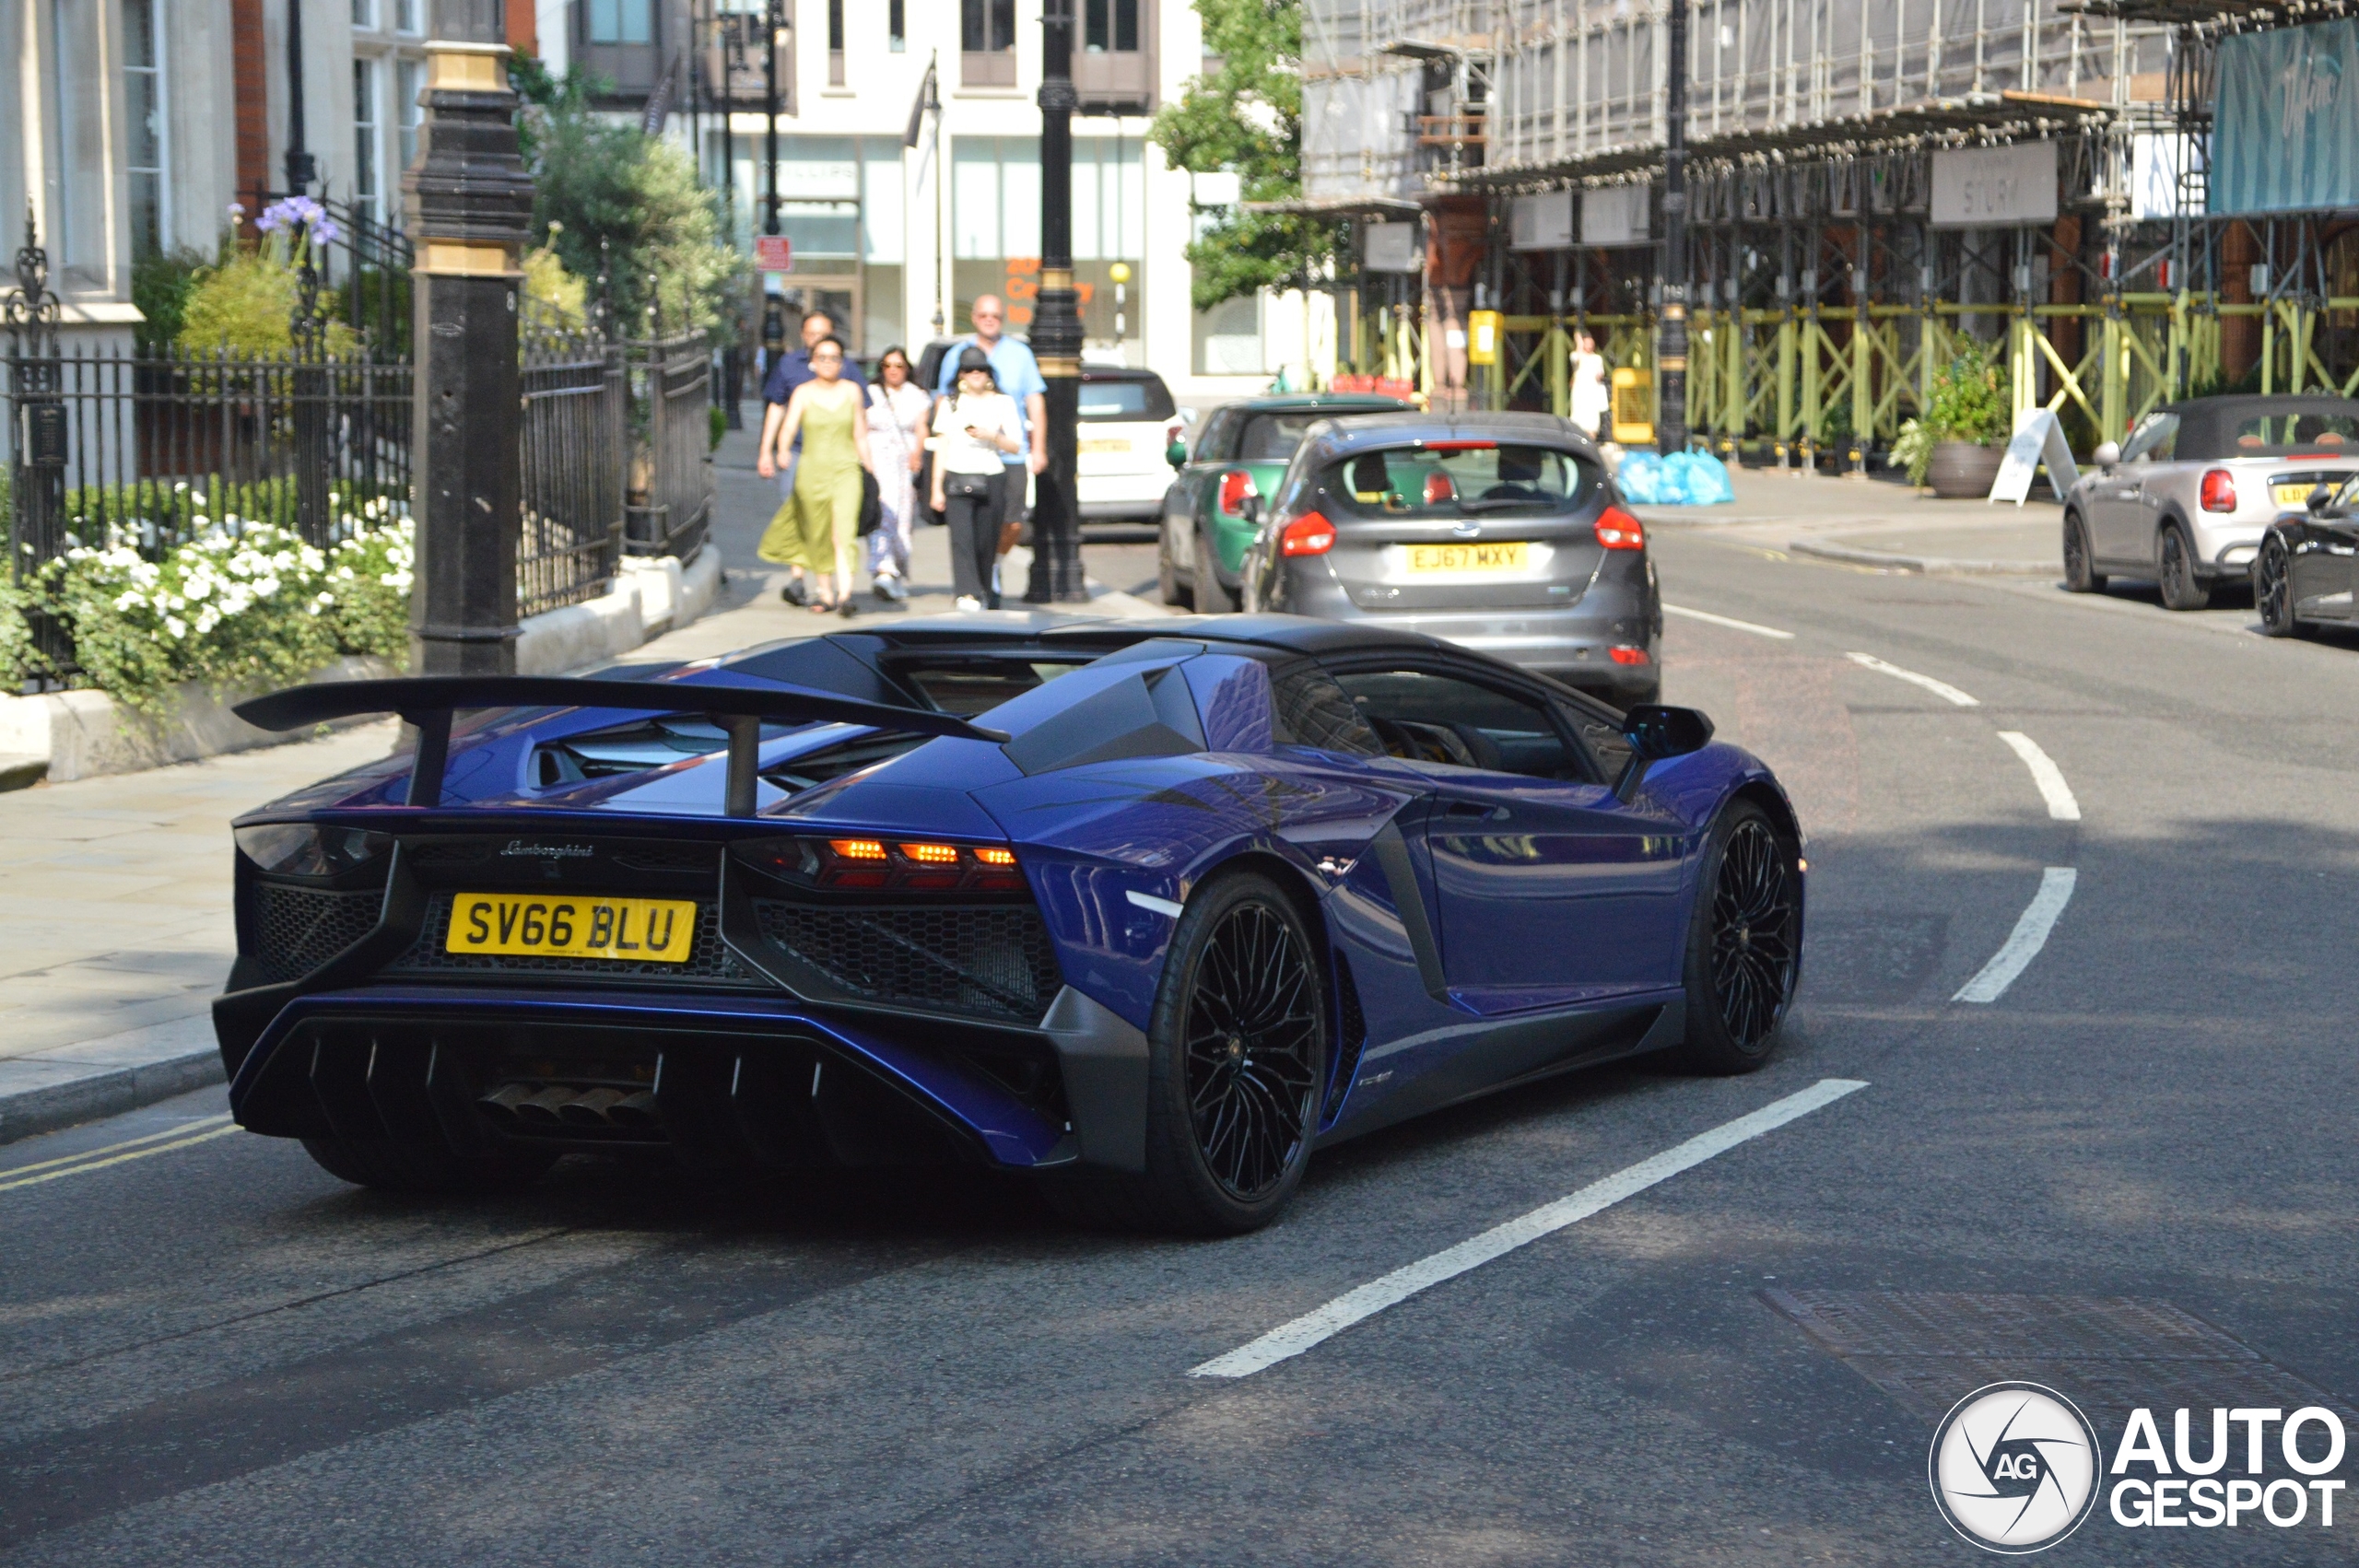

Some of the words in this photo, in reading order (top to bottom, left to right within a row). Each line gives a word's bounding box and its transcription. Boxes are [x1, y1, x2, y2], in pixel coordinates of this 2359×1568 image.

[1414, 549, 1469, 568] EJ67
[1477, 546, 1518, 565] MXY
[499, 840, 593, 859] Lamborghini
[466, 902, 576, 947] SV66
[586, 906, 675, 952] BLU
